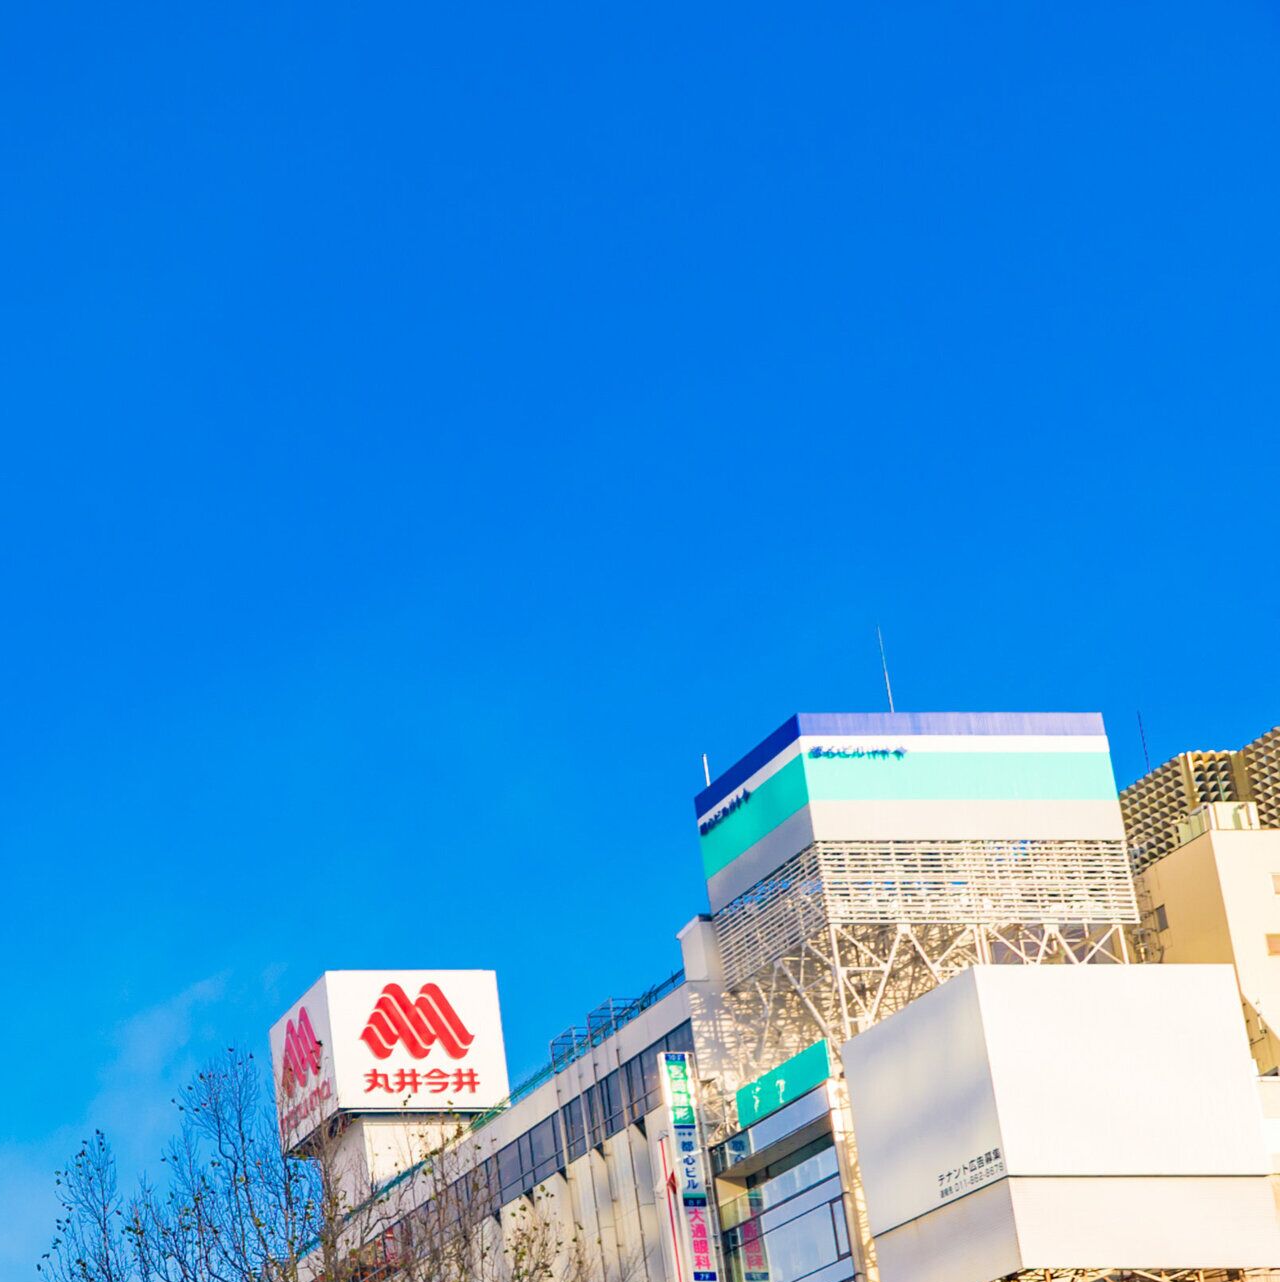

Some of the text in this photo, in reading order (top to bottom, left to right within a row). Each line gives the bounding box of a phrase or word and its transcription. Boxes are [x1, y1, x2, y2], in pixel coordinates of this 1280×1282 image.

[363, 1068, 481, 1094] 丸井今井
[681, 1142, 699, 1189] 都心ビル
[689, 1209, 711, 1270] 大通眼科
